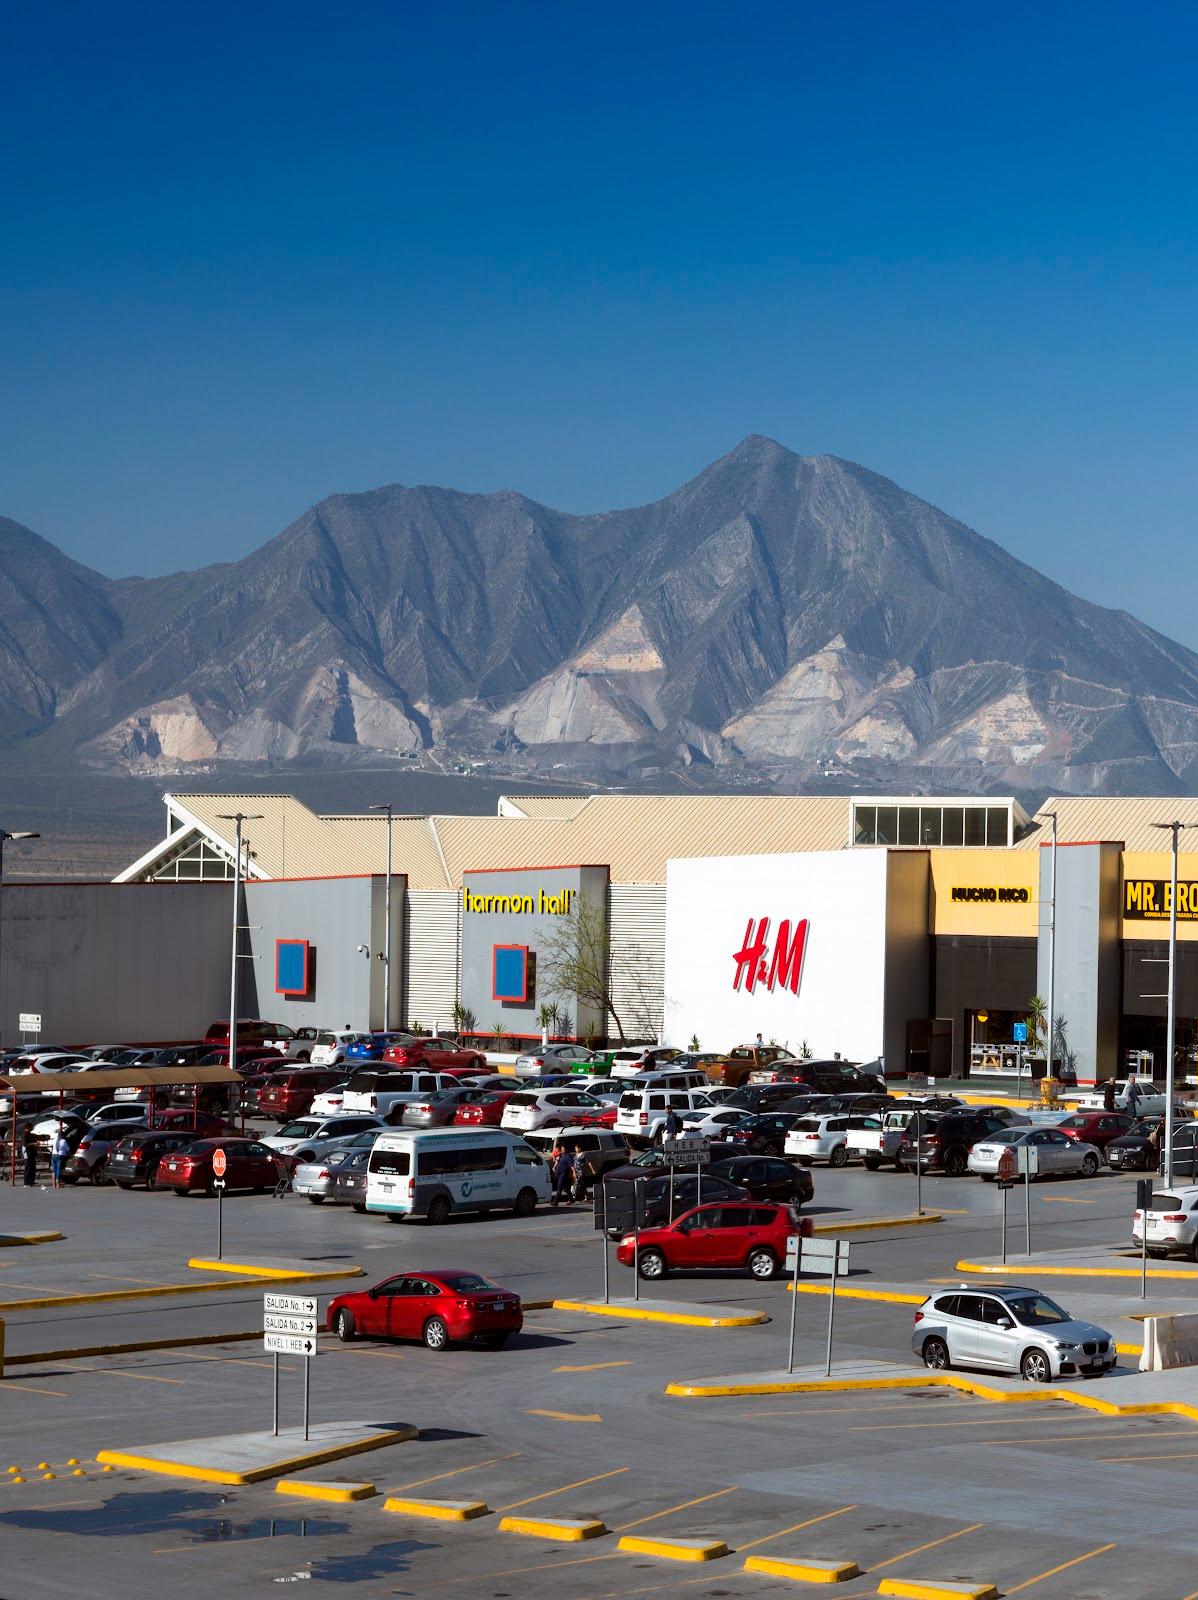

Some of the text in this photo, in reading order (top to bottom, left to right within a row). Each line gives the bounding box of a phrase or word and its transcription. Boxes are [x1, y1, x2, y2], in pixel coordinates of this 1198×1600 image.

[463, 887, 570, 914] harmon hall
[952, 888, 1028, 903] MUCHO RICO
[1127, 882, 1159, 911] MR.
[733, 917, 809, 996] H&M
[675, 1154, 696, 1163] SALIDA
[267, 1297, 305, 1311] SALIDA No. 1
[266, 1317, 305, 1331] SALIDA No. 2
[267, 1337, 284, 1349] NIVEL
[290, 1340, 303, 1351] HEB
